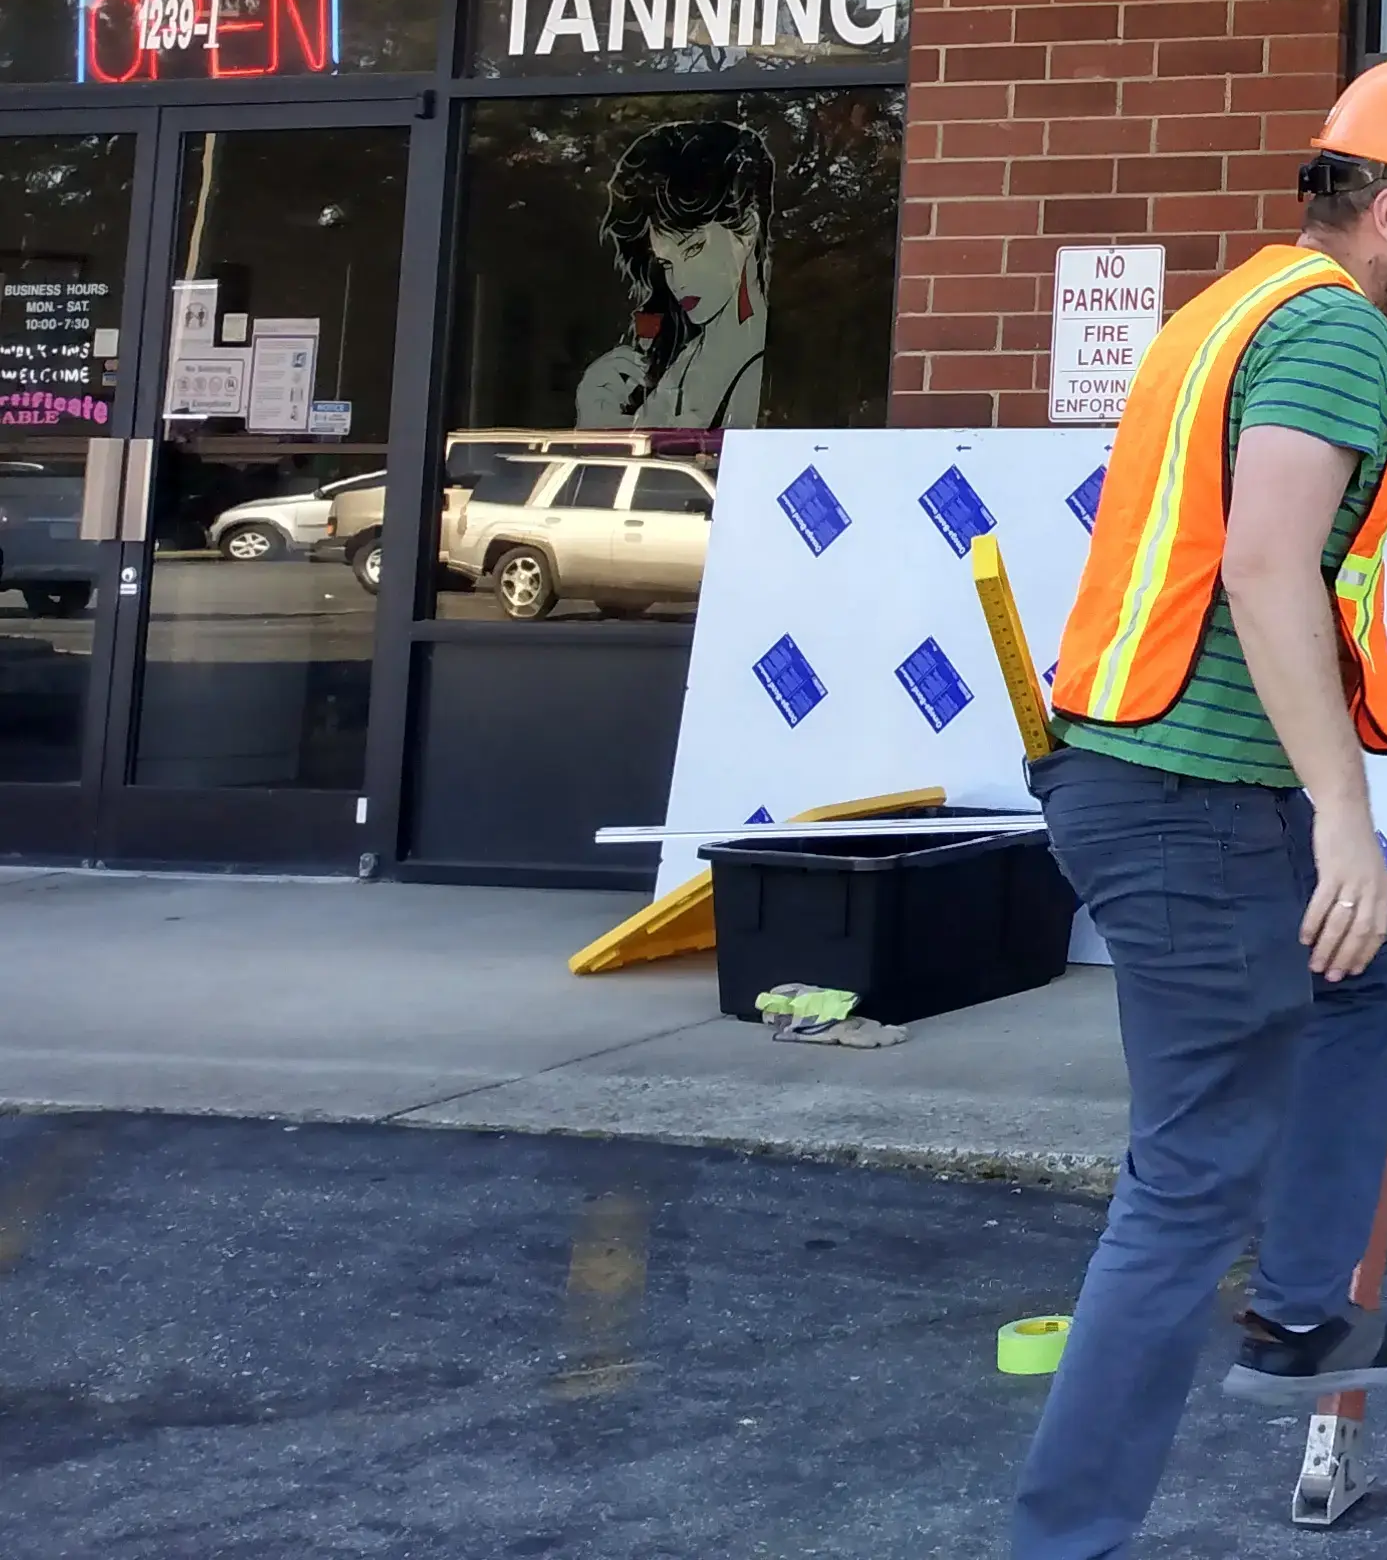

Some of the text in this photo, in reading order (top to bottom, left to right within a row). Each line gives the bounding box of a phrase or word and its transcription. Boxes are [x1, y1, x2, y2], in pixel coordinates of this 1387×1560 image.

[1095, 255, 1125, 279] NO
[4, 283, 109, 296] BUSINESS HOURS:
[1062, 287, 1155, 312] PARKING
[1084, 325, 1129, 343] FIRE
[1078, 348, 1133, 366] LANE
[1, 366, 90, 384] WELCOME
[1069, 379, 1127, 394] TOWIN
[1055, 399, 1127, 413] ENFORC
